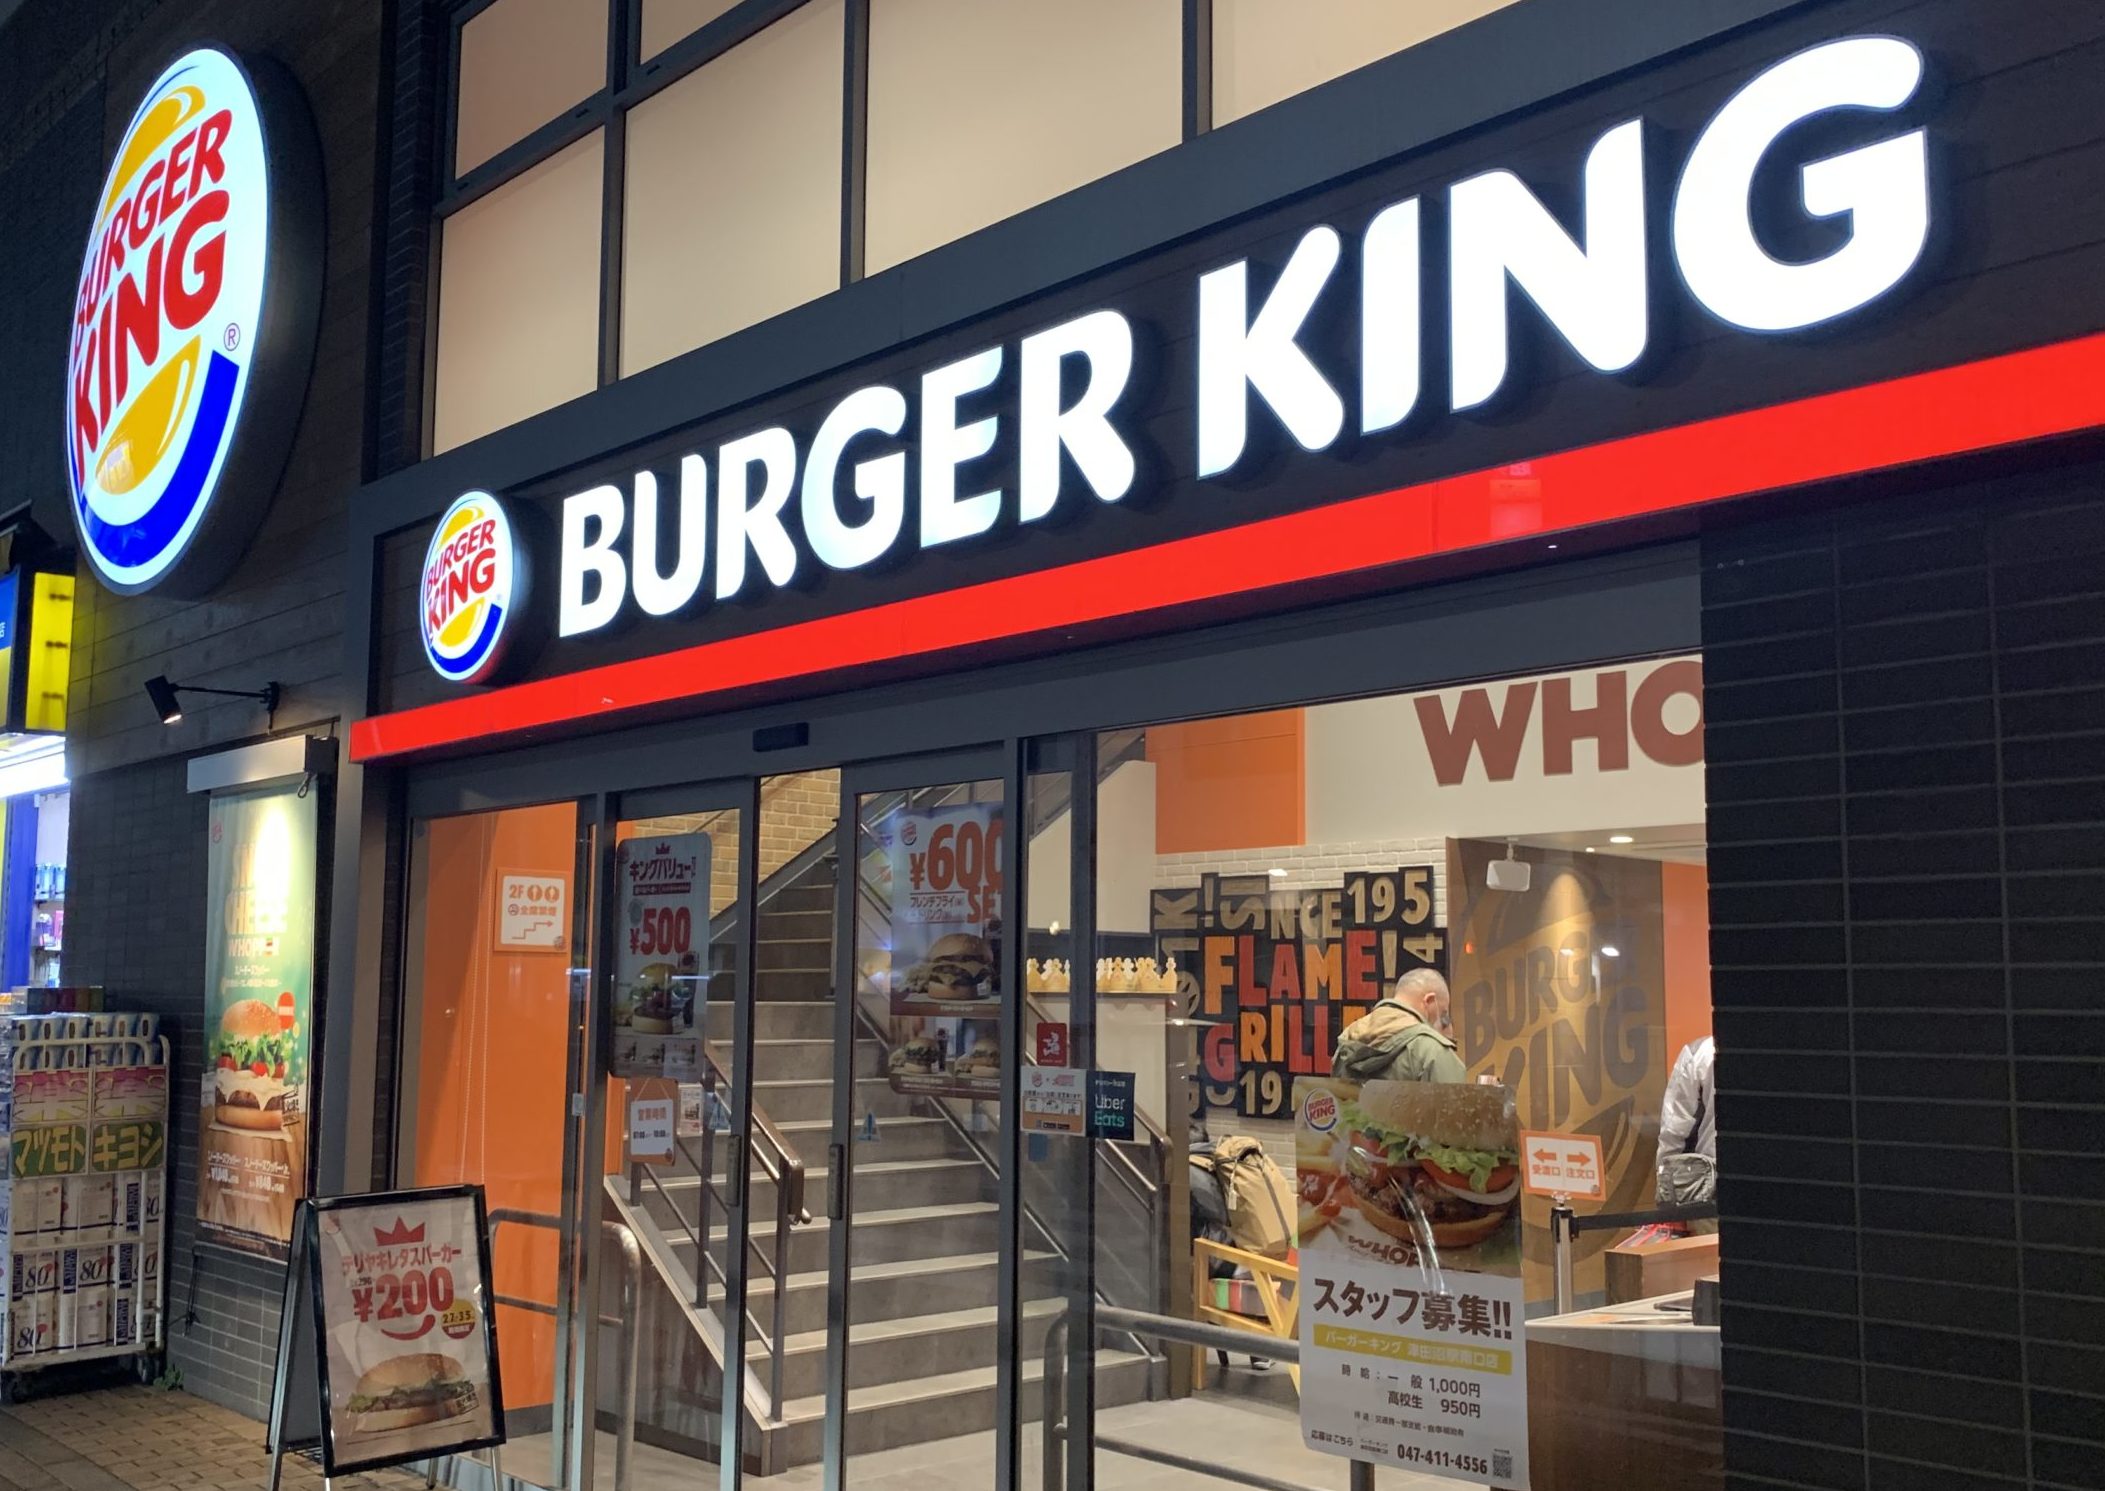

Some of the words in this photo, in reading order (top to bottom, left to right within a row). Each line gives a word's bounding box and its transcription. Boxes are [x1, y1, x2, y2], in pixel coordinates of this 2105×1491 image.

[74, 109, 232, 360] BURGER
[74, 190, 229, 489] KING
[558, 310, 1134, 638] BURGER
[1197, 34, 1928, 480] KING
[427, 519, 496, 599] BURGER
[428, 548, 496, 636] KING
[1413, 660, 1704, 786] WHO
[509, 884, 525, 899] 2F
[966, 886, 1003, 924] SE
[629, 905, 692, 955] ¥500
[1204, 1004, 1367, 1083] GRILL
[1095, 1094, 1126, 1110] Uber
[1239, 1069, 1294, 1116] 19
[1308, 1097, 1334, 1112] BURGER
[1309, 1104, 1336, 1121] KING
[1094, 1110, 1125, 1128] Eats
[13, 1125, 85, 1178] マツモト
[93, 1123, 163, 1170] キヨシ
[80, 1259, 103, 1281] 80
[352, 1266, 454, 1323] ¥200
[1313, 1278, 1512, 1340] スタッフ募集!!
[1326, 1330, 1402, 1355] バーガーキング
[1440, 1399, 1481, 1419] 950円
[1397, 1443, 1488, 1475] 047-411-4556
